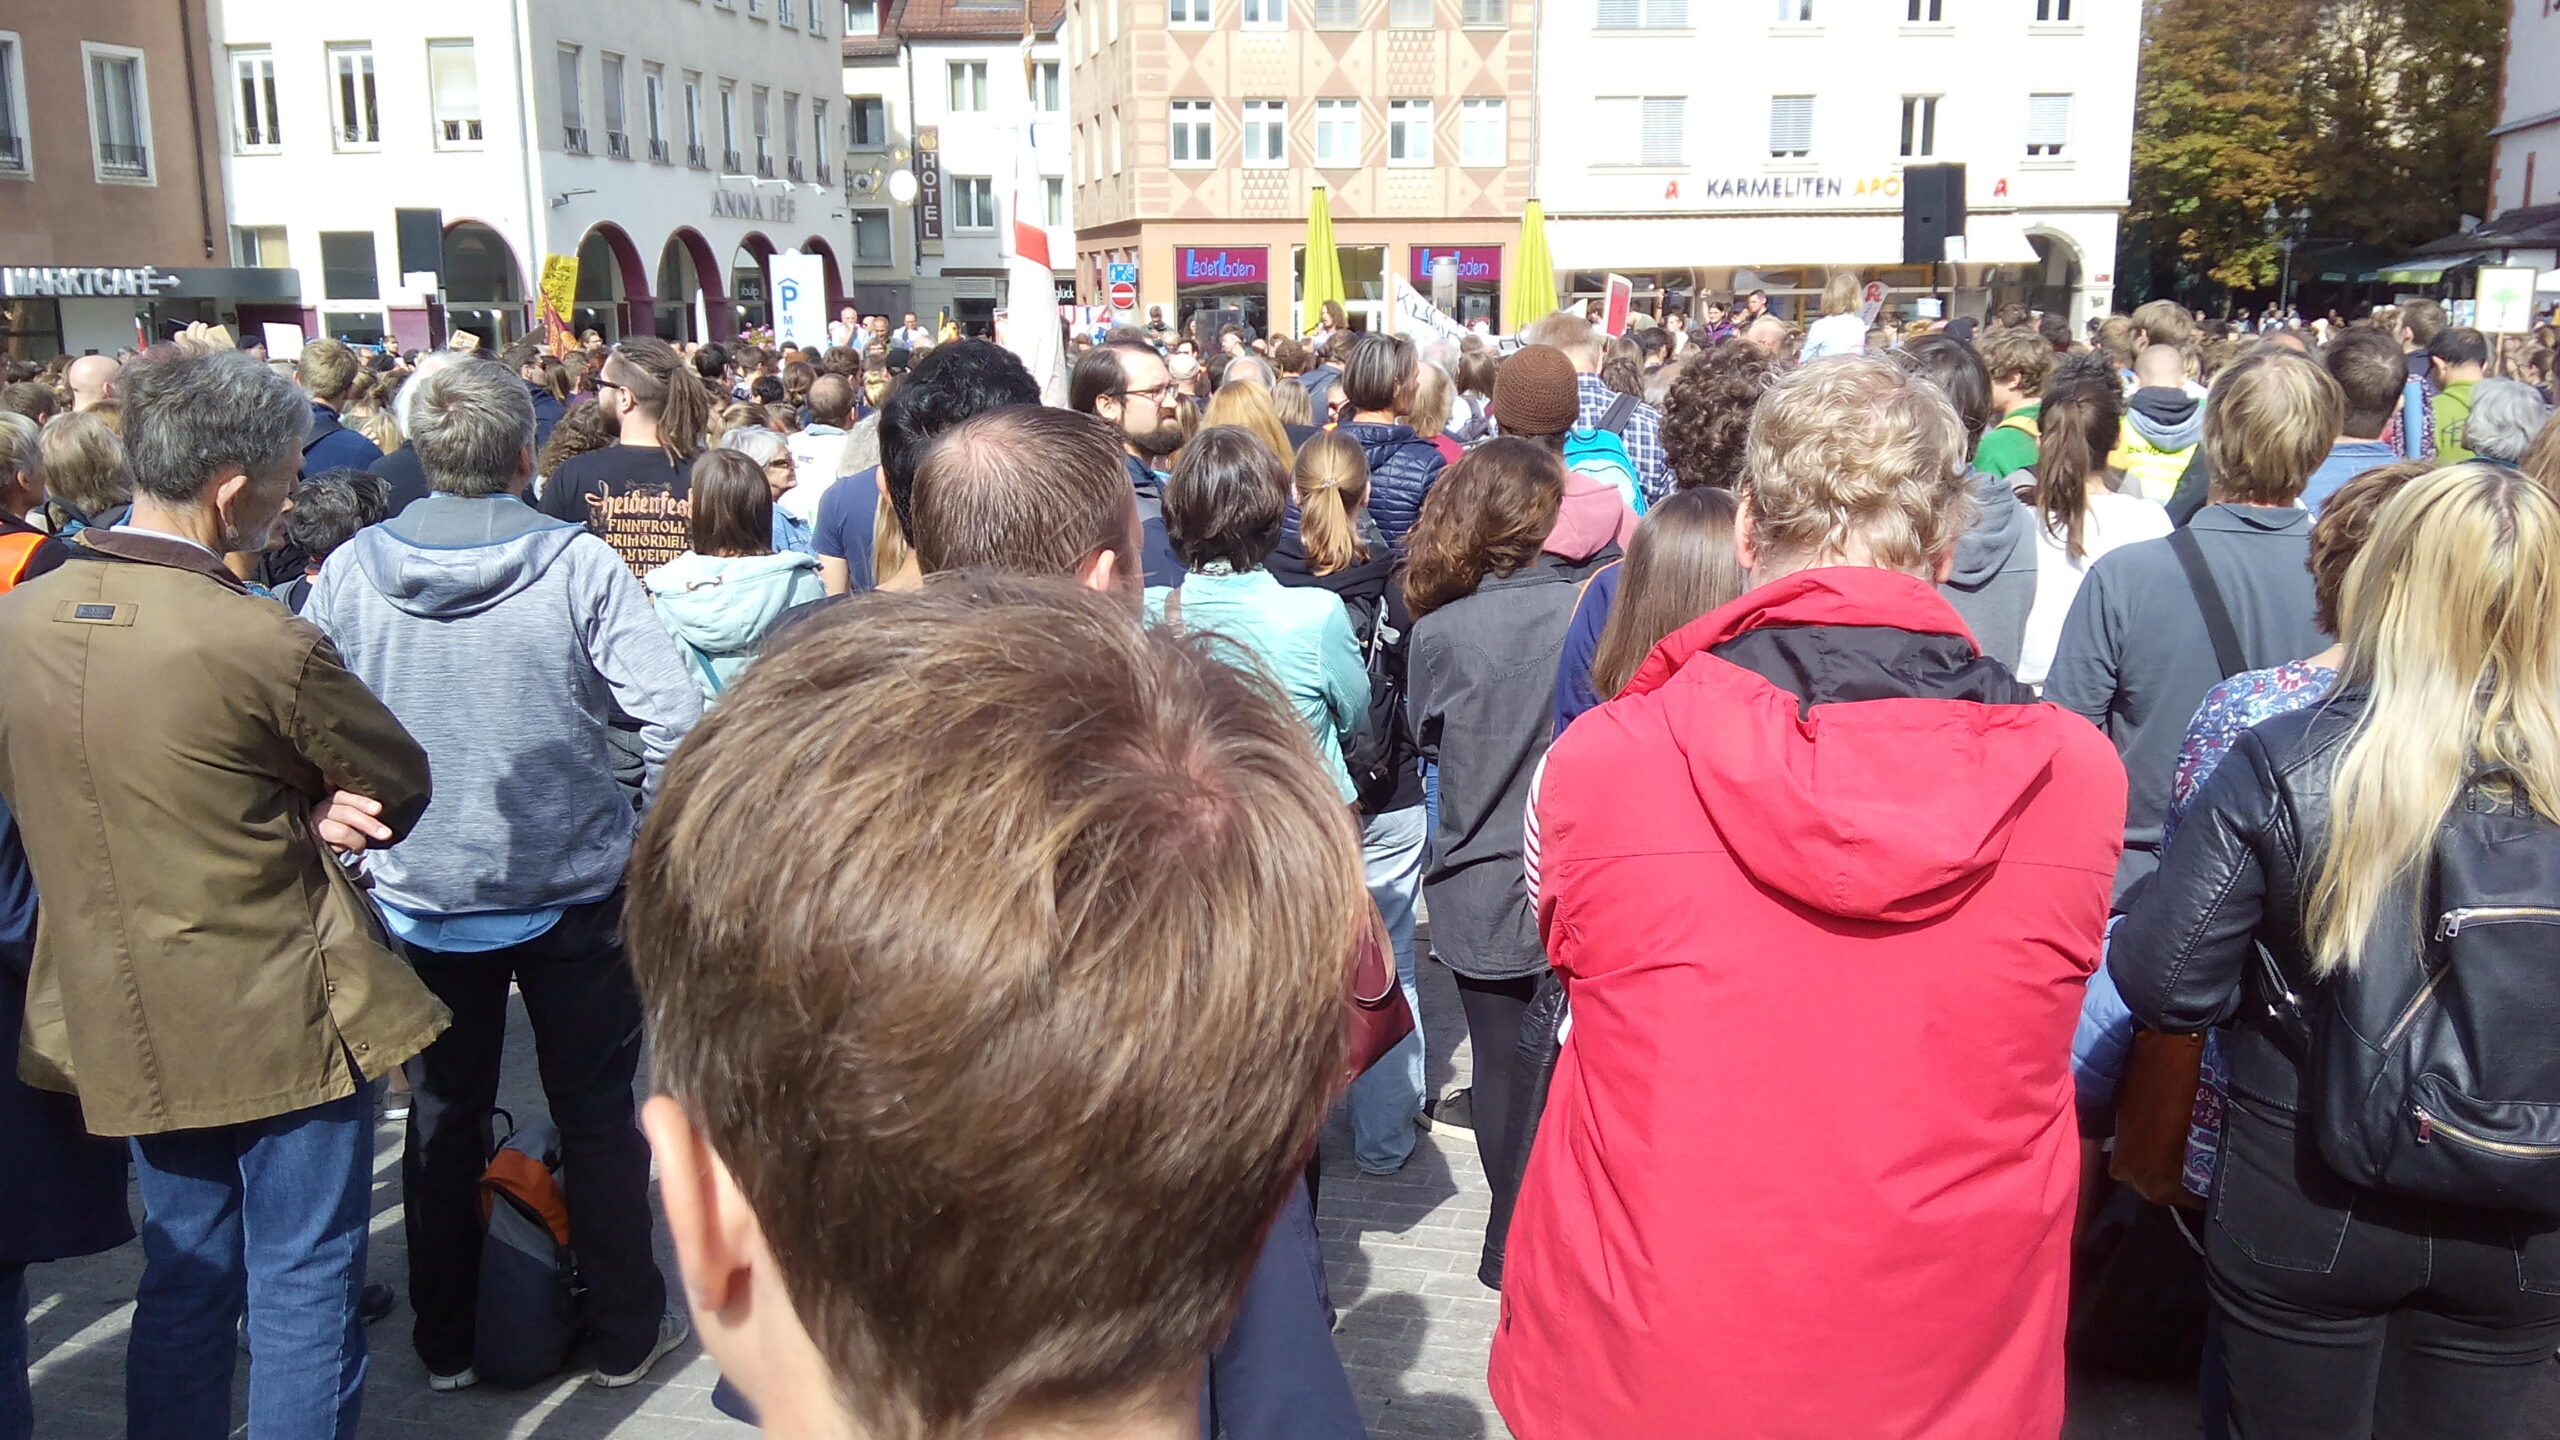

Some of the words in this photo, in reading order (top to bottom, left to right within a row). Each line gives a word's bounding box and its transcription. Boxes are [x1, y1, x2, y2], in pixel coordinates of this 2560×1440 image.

[922, 153, 938, 237] HOTEL
[1706, 177, 1843, 198] KARMELITEN
[1854, 175, 1900, 198] APO
[711, 191, 764, 220] ANNA
[781, 286, 797, 311] P
[608, 519, 686, 533] FINNTROLL
[605, 533, 688, 549] PRIMORDIAL
[618, 548, 682, 562] LUVEITIE
